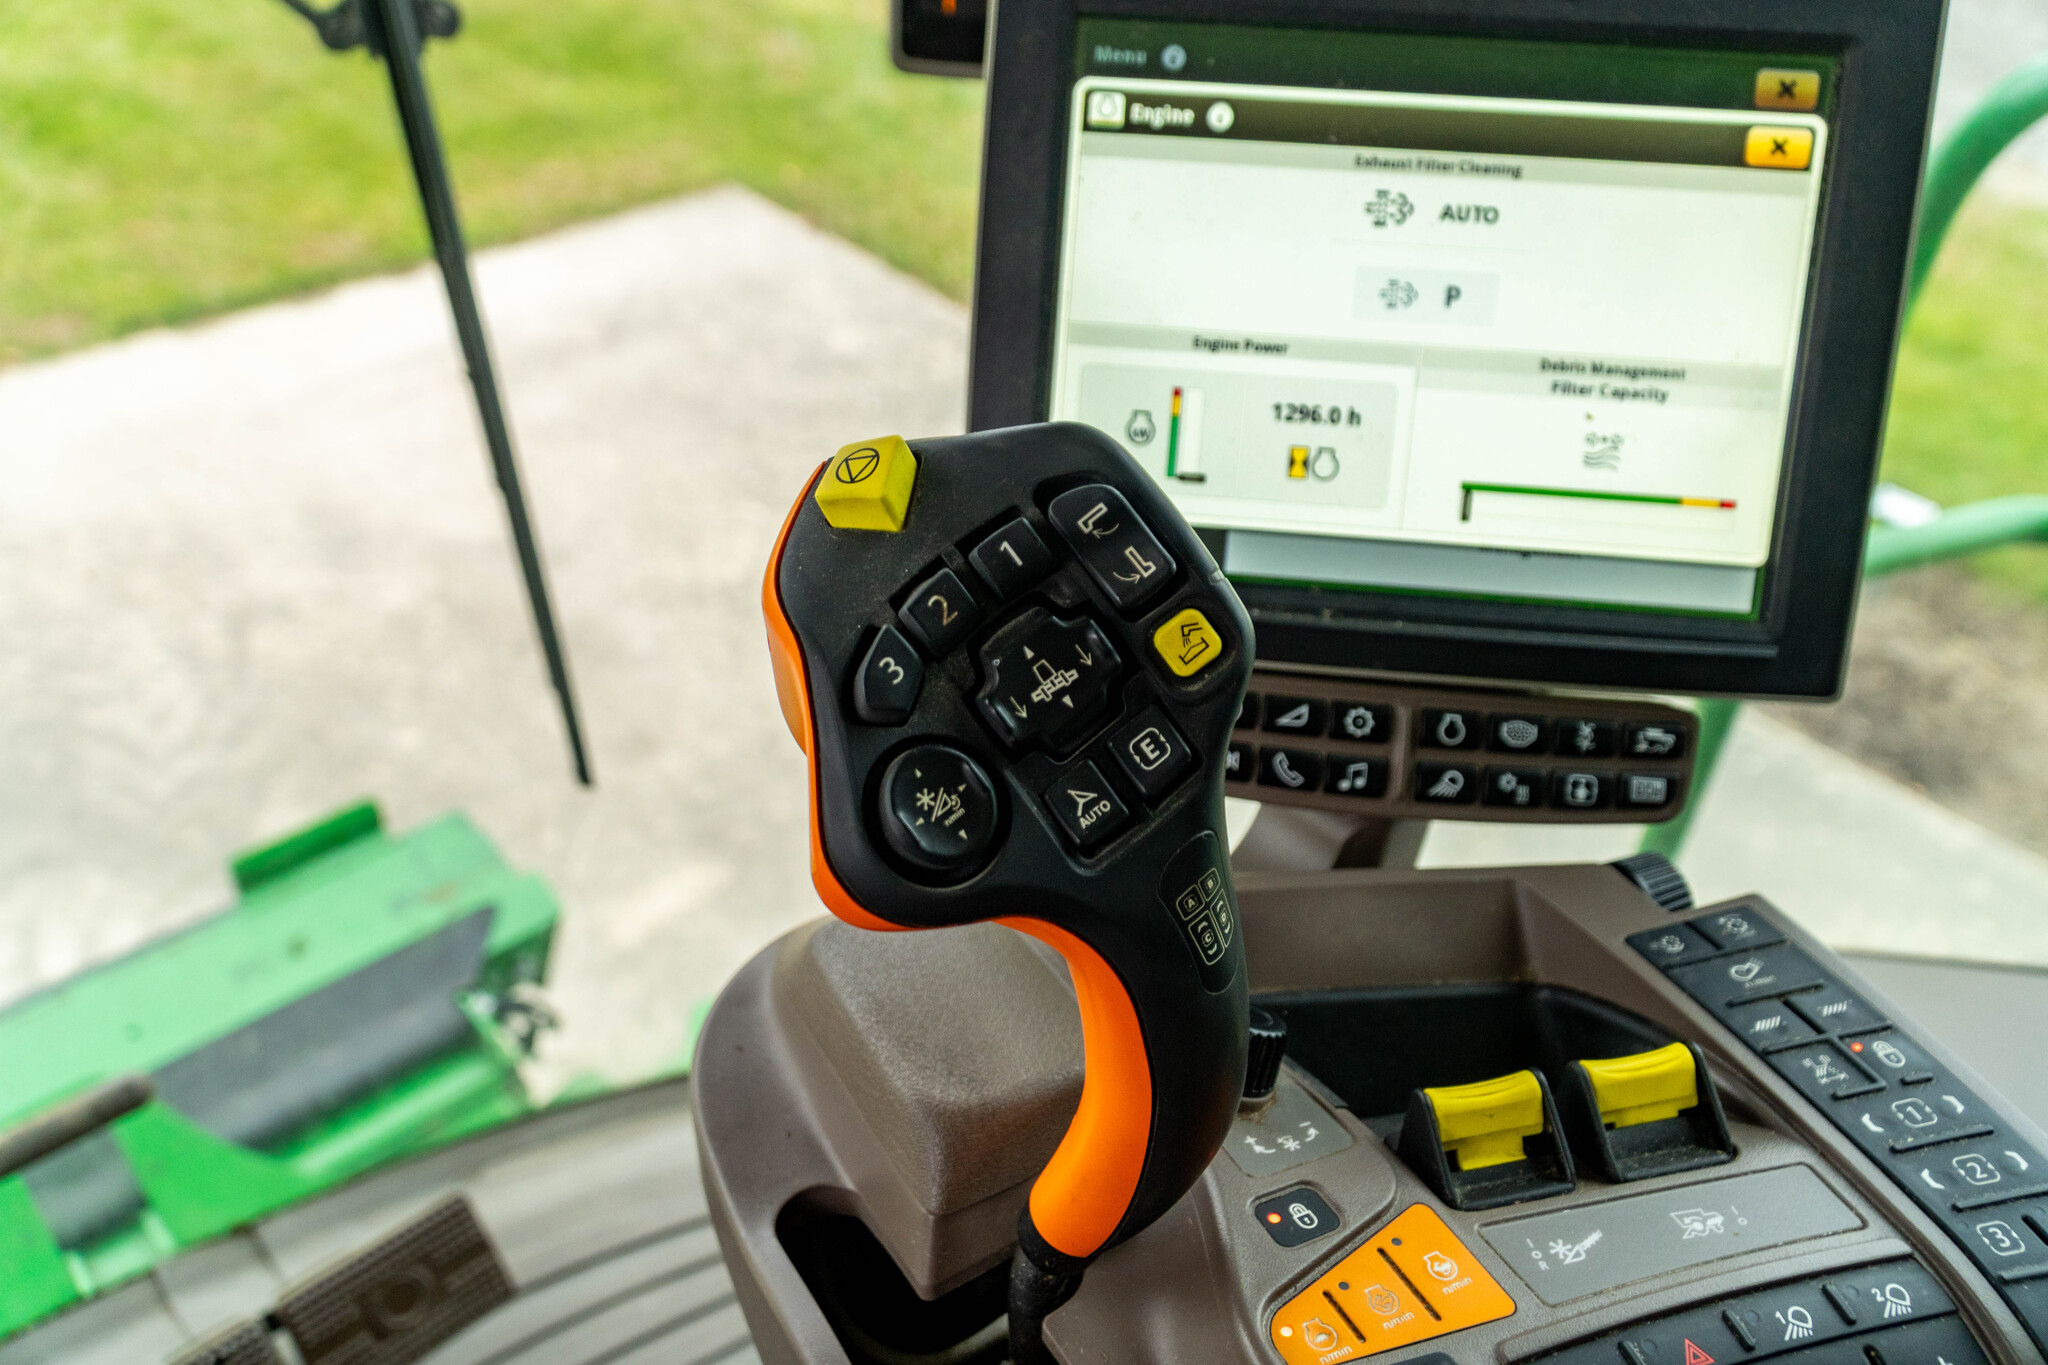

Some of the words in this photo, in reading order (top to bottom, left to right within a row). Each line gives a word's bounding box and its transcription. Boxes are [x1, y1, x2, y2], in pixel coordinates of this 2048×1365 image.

[1094, 46, 1147, 64] Menu
[1130, 103, 1195, 129] Engine
[1355, 154, 1412, 170] Exhaust
[1417, 157, 1454, 172] Filter
[1460, 160, 1523, 179] Cleaning
[1439, 204, 1499, 224] AUTO
[1445, 285, 1462, 308] P
[1193, 336, 1240, 352] Engine
[1245, 338, 1289, 354] Power
[1540, 358, 1587, 375] Debris
[1590, 361, 1686, 381] Management
[1551, 380, 1593, 397] Filter
[1599, 383, 1669, 403] Capacity
[1273, 403, 1341, 425] 1296.0
[1348, 406, 1361, 427] h
[1000, 540, 1024, 567] 1
[927, 594, 958, 626] 2
[879, 656, 904, 685] 3
[1140, 737, 1161, 760] E
[1079, 800, 1111, 829] AUTO
[1905, 1106, 1923, 1121] 1
[1971, 1163, 1988, 1179] 2
[1988, 1227, 2010, 1247] 3
[1442, 1277, 1473, 1295] n/min
[1871, 1288, 1885, 1302] 2
[1383, 1311, 1415, 1330] n/min
[1775, 1311, 1786, 1324] 1
[1319, 1345, 1353, 1364] n/min
